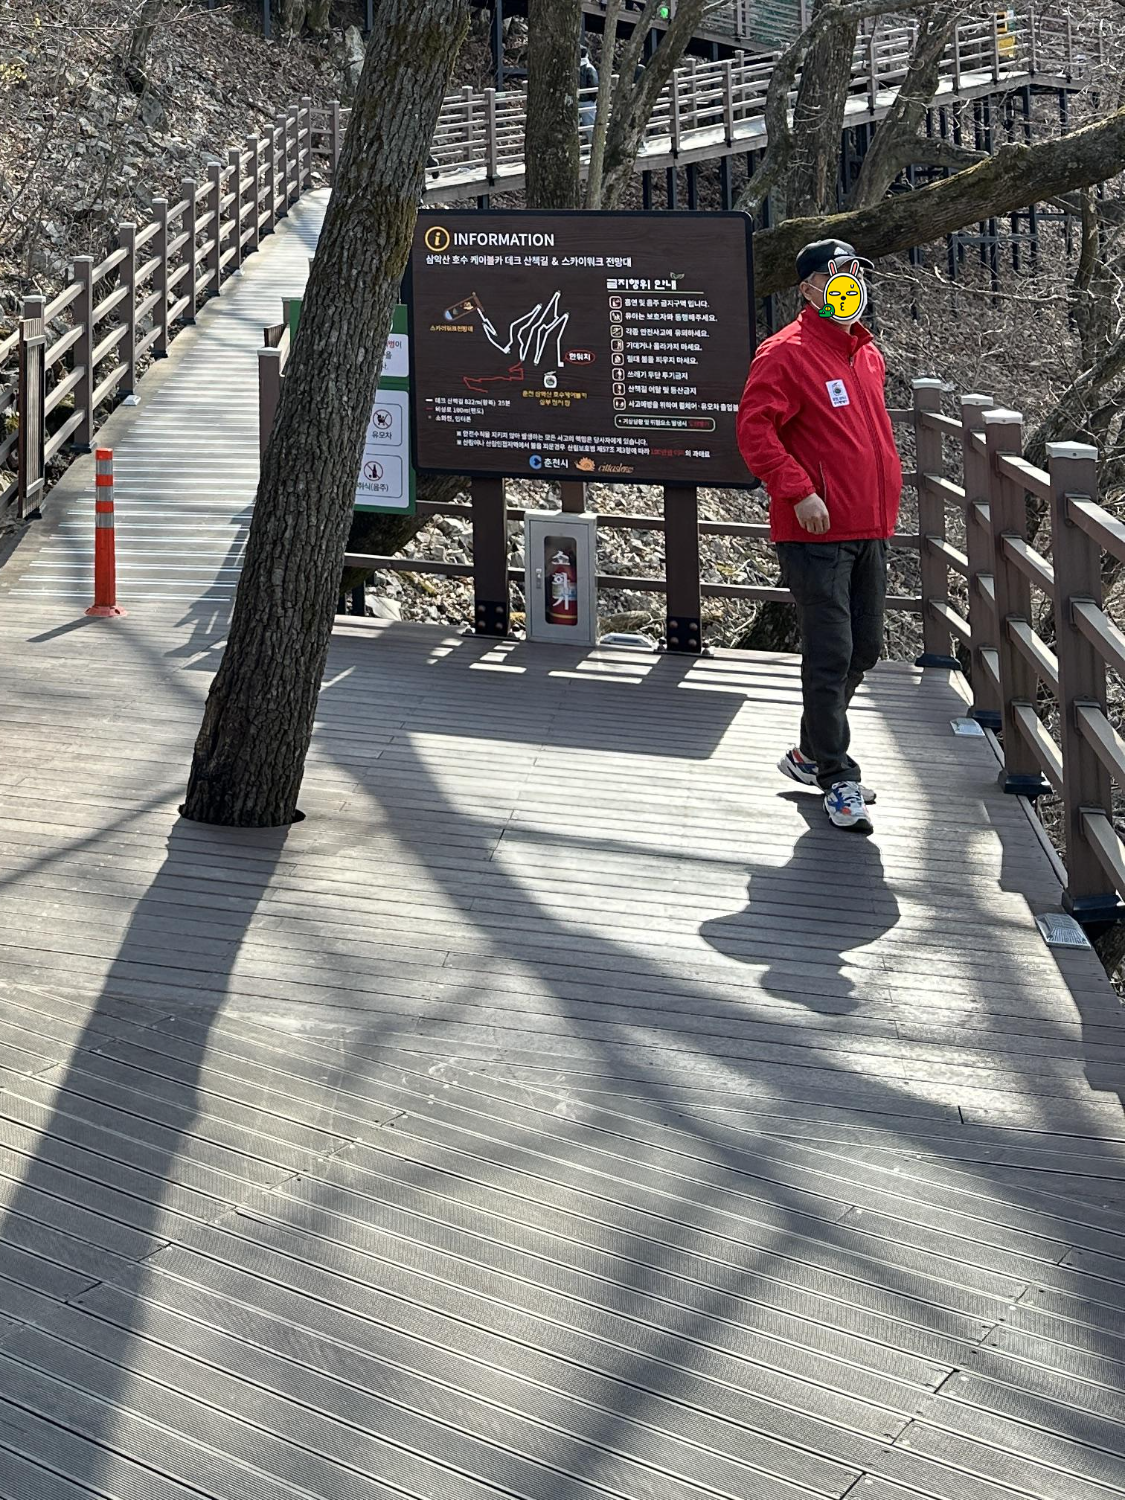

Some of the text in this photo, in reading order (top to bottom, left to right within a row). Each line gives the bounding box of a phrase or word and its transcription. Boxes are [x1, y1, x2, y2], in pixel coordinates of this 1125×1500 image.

[453, 233, 555, 246] INFORMATION
[426, 255, 631, 268] 삼악산 호수 케이블카 데크 산책길 & 스카이워크 전망대
[607, 279, 677, 290] 금지행위 안내
[372, 431, 392, 439] 유모차
[544, 458, 569, 469] 춘천시
[551, 550, 570, 611] 소화기
